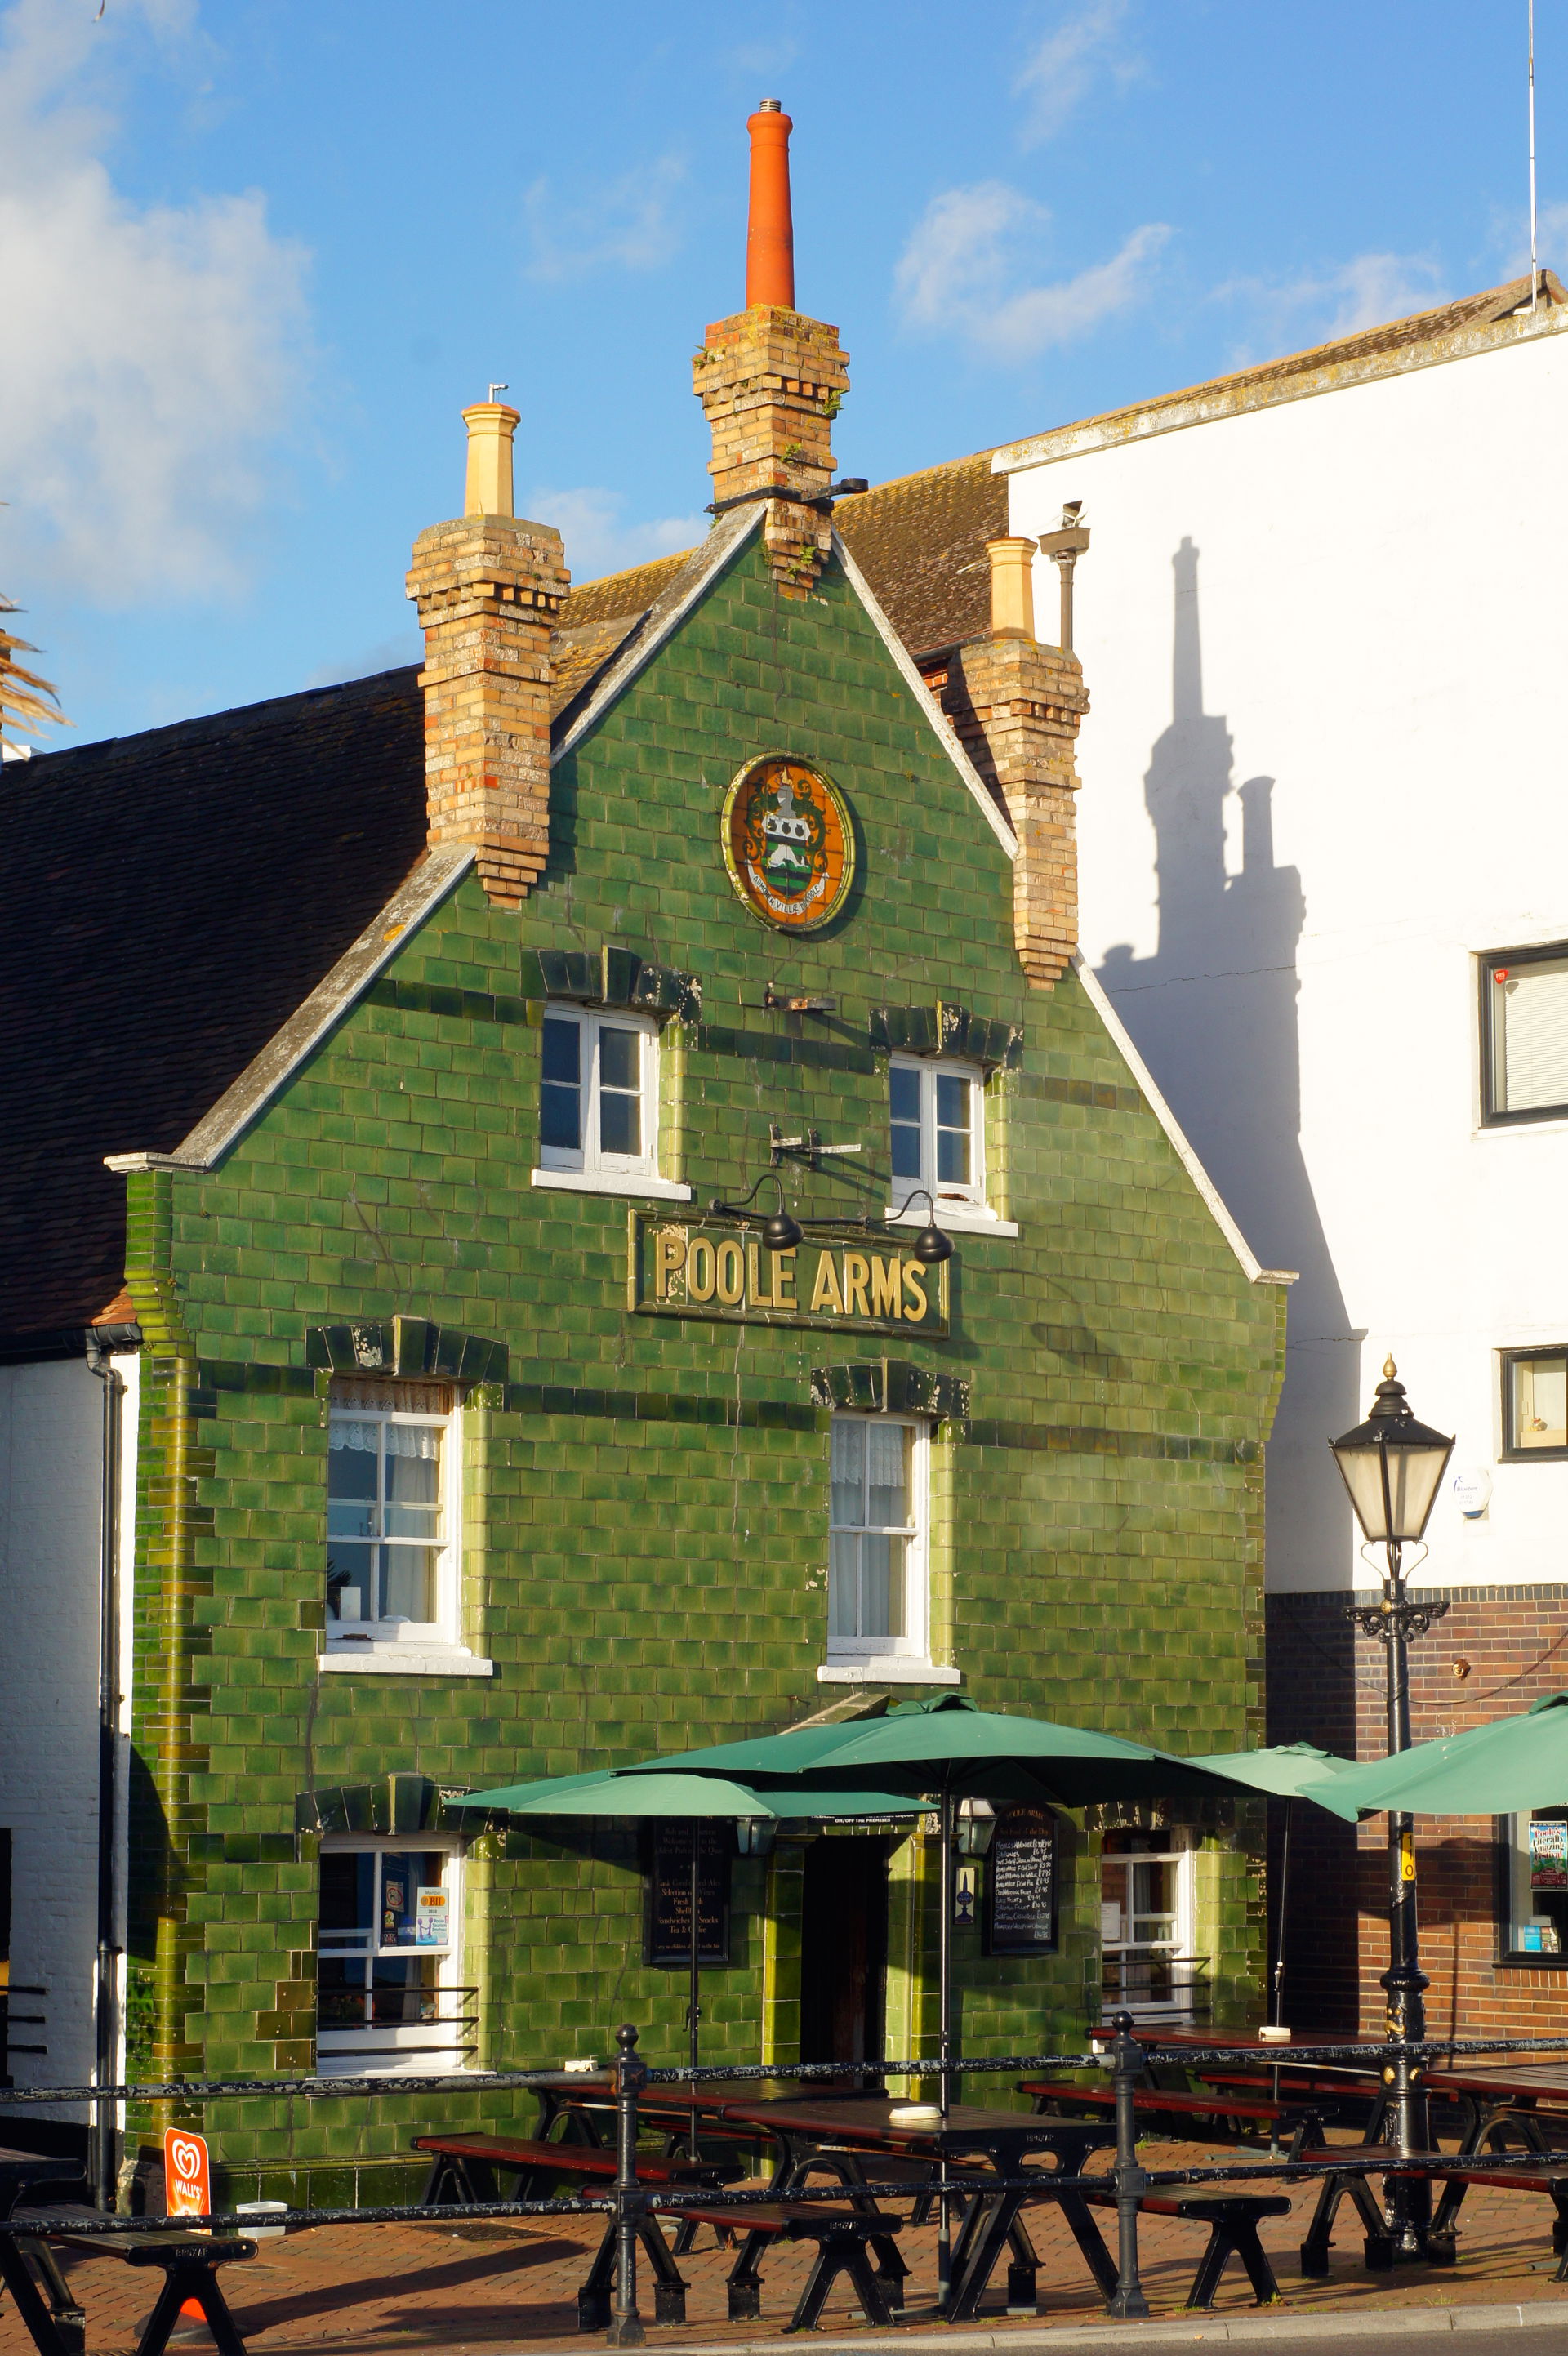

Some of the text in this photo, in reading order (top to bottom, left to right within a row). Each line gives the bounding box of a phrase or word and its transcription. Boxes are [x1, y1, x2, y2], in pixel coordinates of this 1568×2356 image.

[656, 1233, 928, 1322] POOLE ARMS
[1535, 1828, 1561, 1837] Poole's
[1533, 1835, 1564, 1846] Literally
[1534, 1844, 1565, 1853] Amazing
[1535, 1851, 1562, 1861] Festival
[430, 1896, 442, 1906] BII
[674, 1897, 689, 1905] Fresh
[659, 1916, 719, 1924] Sandwiches Snacks
[175, 2179, 201, 2201] WALL'S
